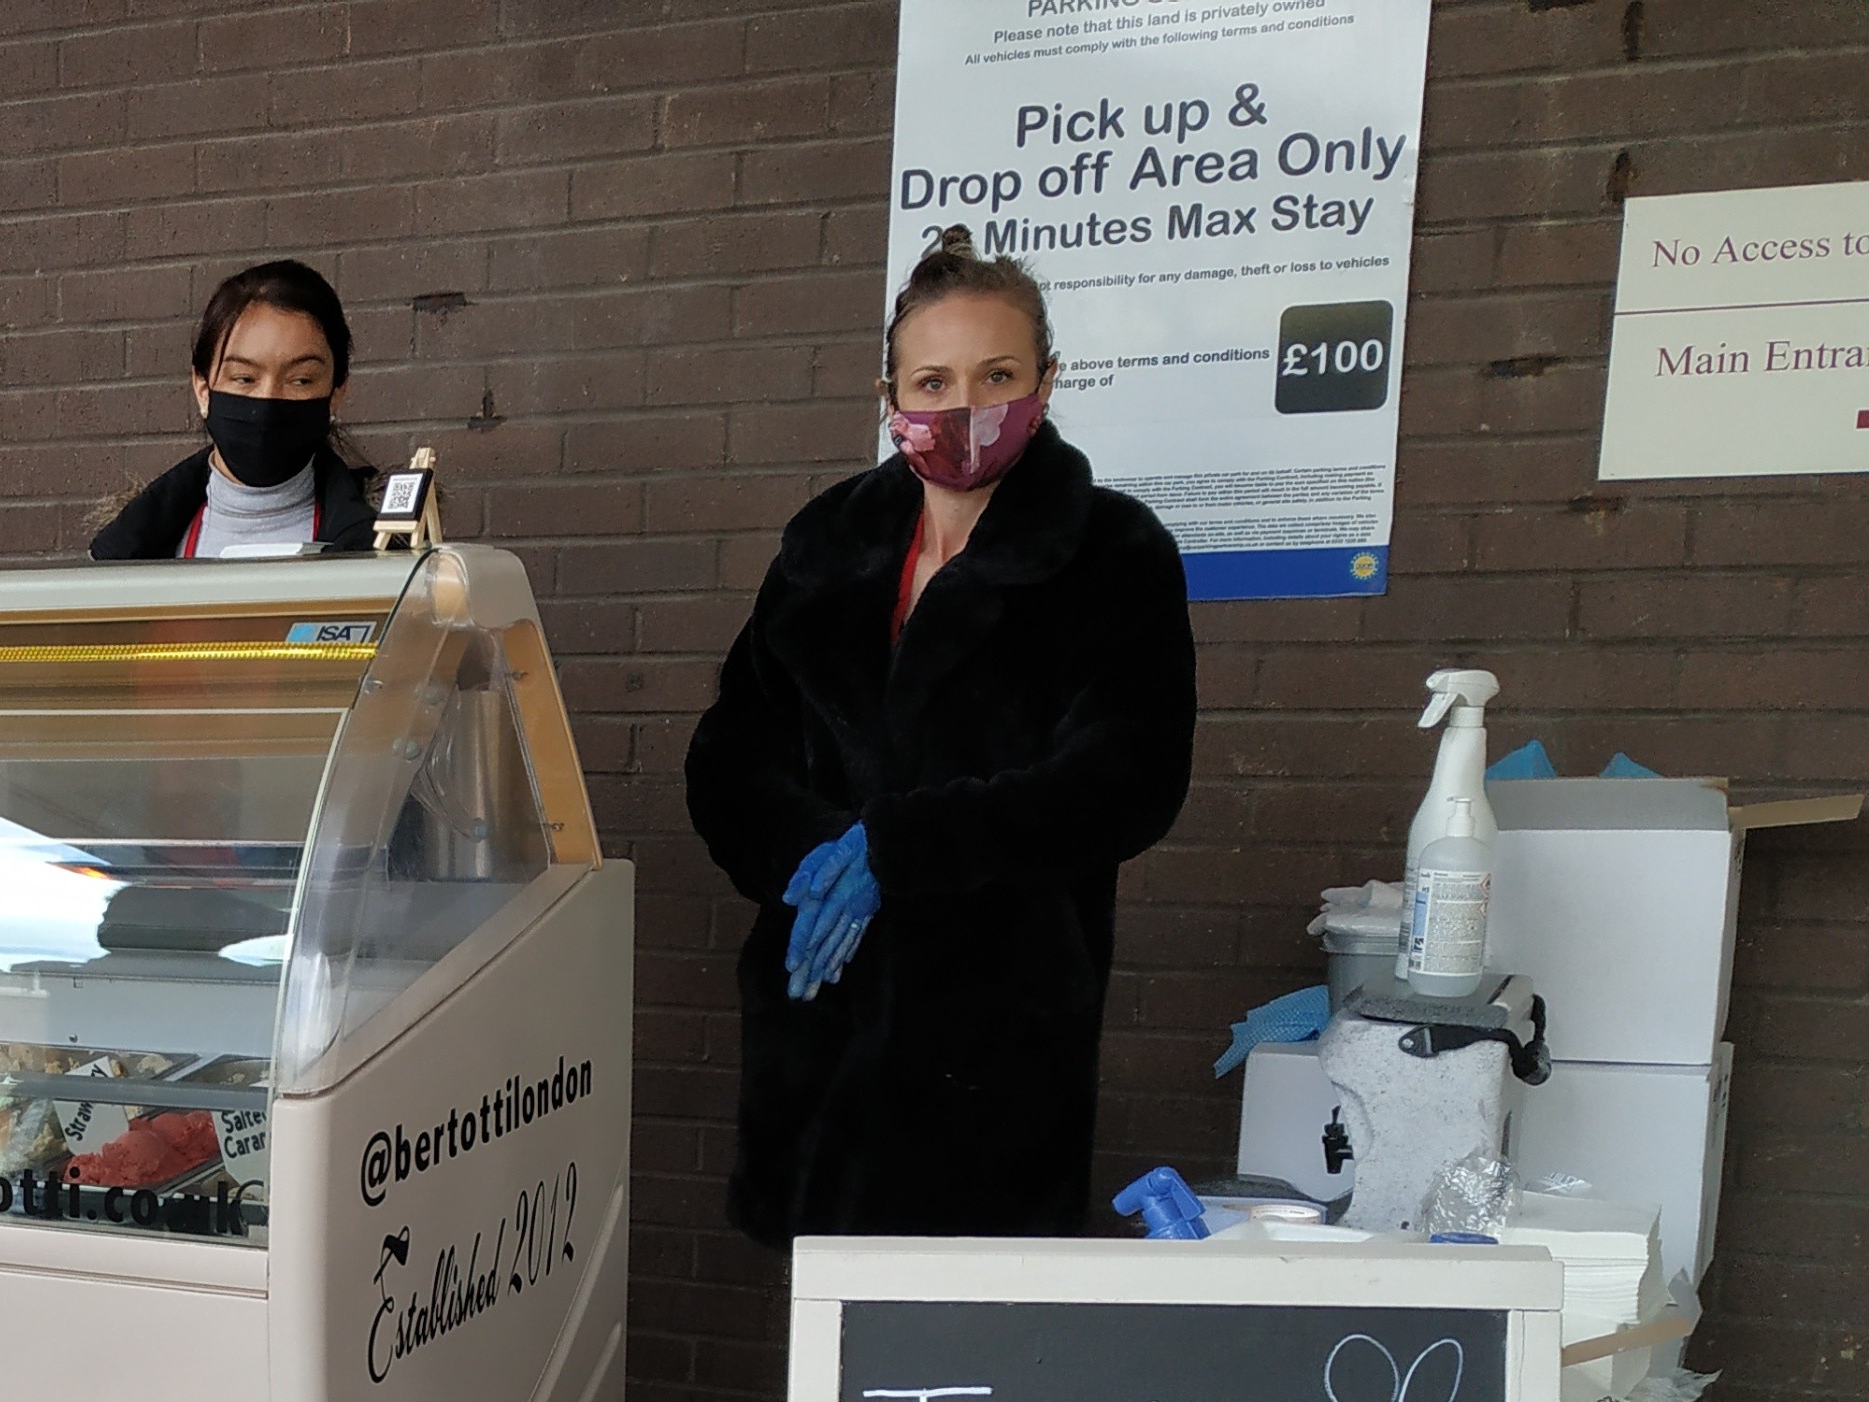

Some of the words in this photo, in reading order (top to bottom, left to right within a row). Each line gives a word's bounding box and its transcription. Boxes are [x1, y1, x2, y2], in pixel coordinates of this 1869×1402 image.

[964, 54, 981, 65] All
[983, 48, 1031, 63] vehicles
[1033, 45, 1063, 58] must
[1065, 40, 1109, 54] comply
[1112, 37, 1137, 49] with
[1140, 35, 1160, 46] the
[1162, 29, 1218, 44] following
[1221, 27, 1258, 38] terms
[1260, 20, 1285, 33] and
[1288, 14, 1355, 30] conditions
[994, 29, 1042, 43] Please
[1047, 24, 1079, 37] note
[1084, 19, 1112, 33] that
[1117, 15, 1143, 30] this
[1148, 11, 1180, 26] land
[1185, 9, 1197, 23] is
[1201, 3, 1269, 23] privately
[1272, 0, 1326, 13] owned
[1016, 98, 1125, 148] Pick
[1144, 99, 1209, 144] up
[1228, 83, 1267, 127] &
[901, 169, 1022, 213] Drop
[1038, 150, 1113, 197] off
[1129, 146, 1259, 190] Area
[1278, 126, 1407, 180] Only
[984, 212, 1152, 256] Minutes
[1168, 203, 1257, 240] Max
[1271, 194, 1375, 236] Stay
[1652, 239, 1700, 268] No
[1711, 235, 1831, 265] Access
[1843, 231, 1869, 256] to
[1054, 275, 1135, 291] responsibility
[1138, 272, 1156, 284] for
[1158, 270, 1181, 285] any
[1184, 267, 1237, 281] damage,
[1241, 263, 1271, 276] theft
[1273, 263, 1287, 274] or
[1290, 260, 1317, 272] loss
[1319, 259, 1333, 271] to
[1335, 254, 1390, 269] vehicles
[1070, 359, 1113, 371] above
[1117, 356, 1159, 368] terms
[1162, 352, 1190, 365] and
[1193, 348, 1270, 363] conditions
[1282, 339, 1385, 376] £100
[1655, 342, 1750, 377] Main
[1764, 340, 1869, 373] Entra
[1054, 376, 1096, 391] harge
[1099, 374, 1115, 386] of
[316, 625, 351, 641] ISA
[360, 1056, 592, 1207] @bertottilondon
[368, 1217, 506, 1384] Established
[507, 1162, 578, 1297] 2012
